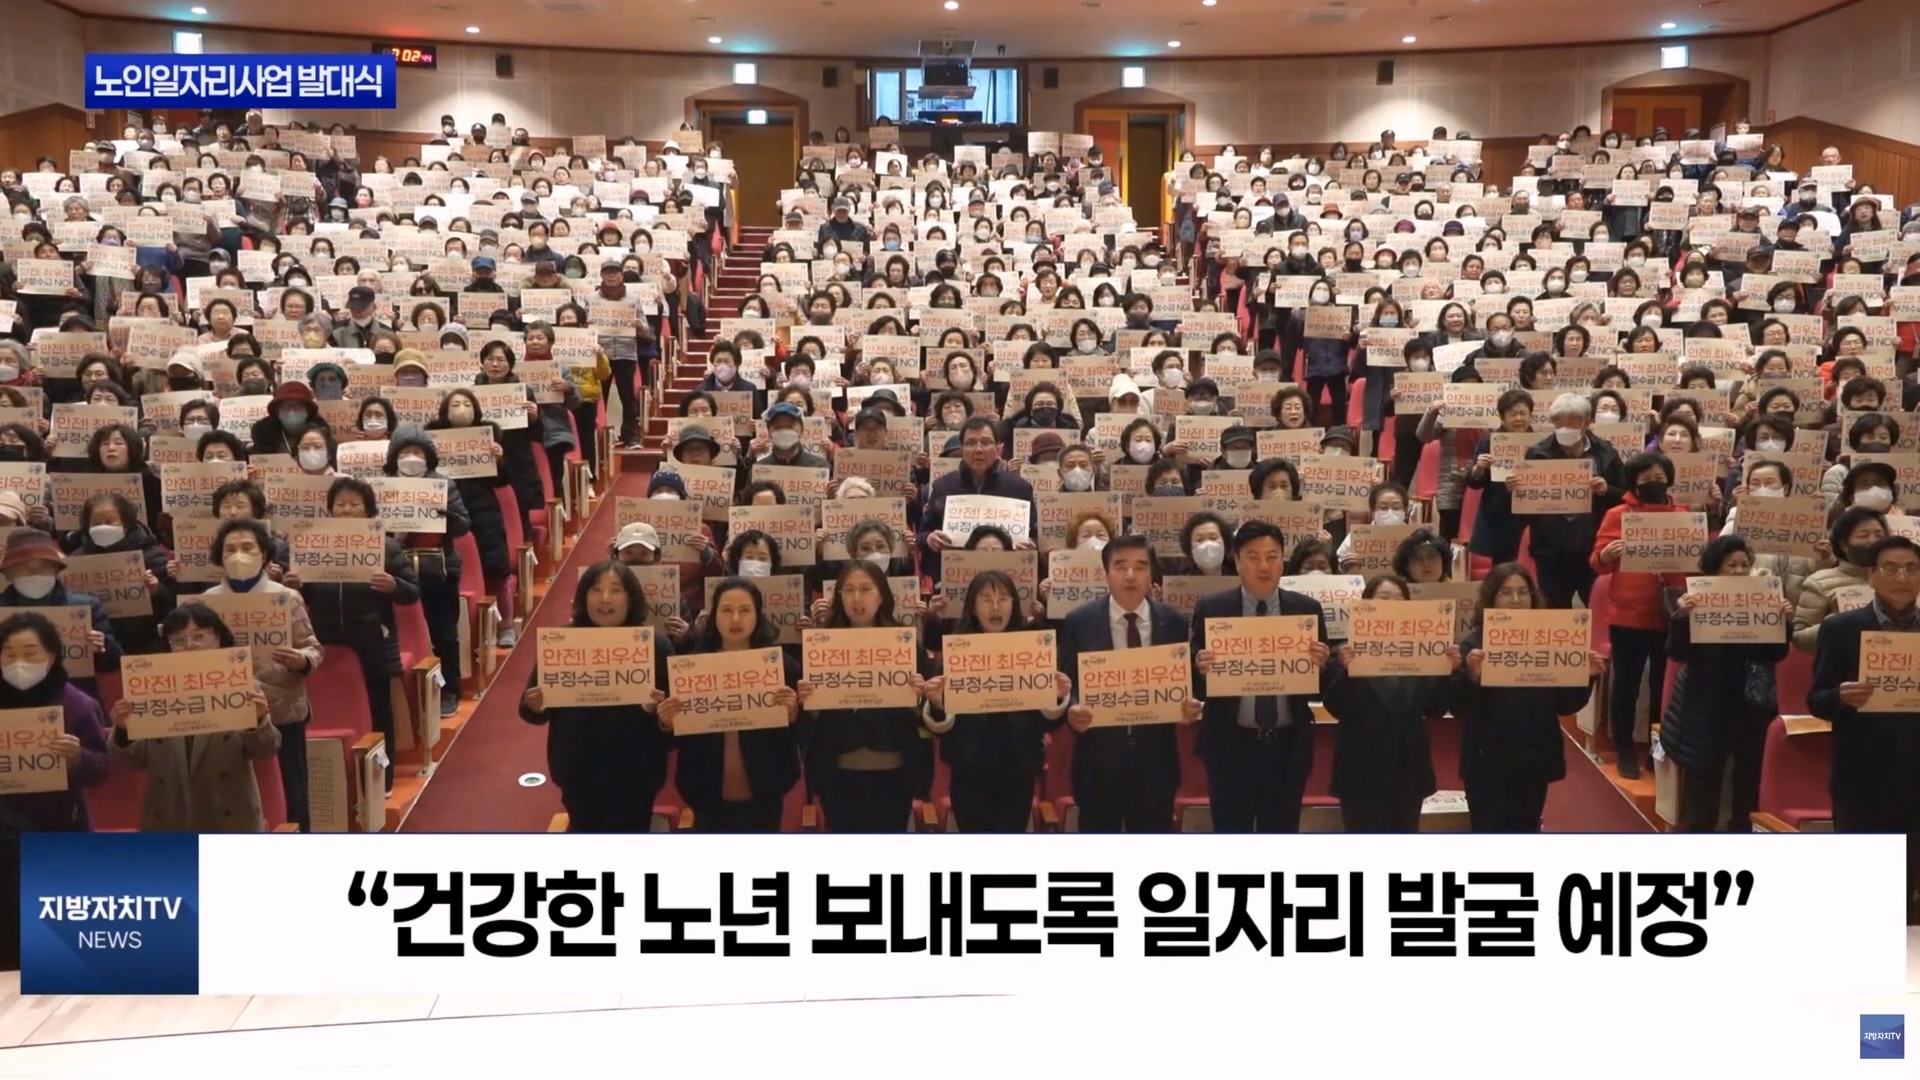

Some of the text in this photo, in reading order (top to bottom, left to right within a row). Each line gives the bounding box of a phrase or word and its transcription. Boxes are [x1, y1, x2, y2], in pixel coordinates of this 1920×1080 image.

[1866, 326, 1895, 336] 최우선
[40, 344, 66, 355] 안전!
[449, 362, 480, 371] 최우선
[901, 358, 918, 367] NO!
[1648, 363, 1676, 373] 최우선
[493, 396, 523, 406] 최우선
[1447, 394, 1471, 404] 안전!
[505, 408, 524, 417] NO!
[1449, 407, 1483, 416] 부정수급
[57, 417, 88, 430] 안전!
[887, 430, 921, 440] 최우선
[1178, 428, 1204, 439] 안전!
[456, 439, 493, 451] 최우선
[1611, 435, 1642, 447] 최우선
[1260, 443, 1287, 454] 안전!
[1494, 446, 1520, 456] 안전!
[341, 453, 368, 464] 안전!
[838, 463, 908, 477] 안전! 최우선
[1304, 467, 1375, 483] 안전! 최우선
[1680, 465, 1714, 478] 최우선
[165, 477, 195, 491] 안전!
[692, 480, 731, 492] 최우선
[787, 480, 826, 493] 최우선
[1114, 479, 1142, 492] 안전!
[1516, 473, 1590, 486] 안전! 최우선
[268, 488, 298, 501] 안전!
[1206, 483, 1233, 496] 안전!
[1304, 482, 1345, 495] 부정수급
[1516, 489, 1589, 500] 부정수급 NO!
[402, 491, 443, 504] 최우선
[655, 513, 698, 527] 최우선
[827, 514, 858, 528] 안전!
[950, 507, 1025, 522] 안전! 최우선
[1042, 509, 1072, 521] 안전!
[1136, 513, 1167, 526] 안전!
[1739, 511, 1824, 528] 안전! 최우선
[770, 520, 811, 533] 최우선
[1278, 516, 1319, 530] 최우선
[294, 534, 381, 549] 안전! 최우선
[1626, 528, 1704, 541] 안전! 최우선
[179, 536, 213, 549] 안전!
[786, 537, 812, 549] NO!
[1354, 540, 1386, 553] 안전!
[294, 552, 380, 566] 부정수급 NO!
[1625, 546, 1674, 558] 부정수급
[95, 567, 142, 584] 최우선
[1052, 568, 1088, 582] 안전!
[115, 586, 145, 600] NO!
[1318, 590, 1362, 604] 최우선
[1694, 591, 1781, 608] 안전! 최우선
[232, 610, 287, 627] 최우선
[1695, 610, 1783, 626] 부정수급 NO!
[1354, 619, 1450, 637] 안전! 최우선
[254, 631, 287, 646] NO!
[1489, 628, 1587, 646] 안전! 최우선
[1211, 635, 1314, 655] 안전! 최우선
[1354, 641, 1449, 657] 부정수급 NO!
[543, 646, 649, 666] 안전! 최우선
[808, 648, 911, 667] 안전! 최우선
[949, 651, 1051, 673] 안전! 최우선
[1488, 651, 1587, 667] 부정수급 NO!
[1866, 652, 1912, 671] 안전!
[1211, 658, 1315, 676] 부정수급 NO!
[129, 669, 248, 695] 안전! 최우선
[543, 669, 650, 688] 부정수급 NO!
[675, 668, 779, 694] 안전! 최우선
[809, 670, 912, 688] 부정수급 NO!
[949, 673, 1053, 693] 부정수급 NO!
[1084, 664, 1186, 688] 안전! 최우선
[1084, 686, 1188, 707] 부정수급 NO!
[130, 692, 250, 717] 부정수급 NO!
[18, 753, 61, 770] NO!
